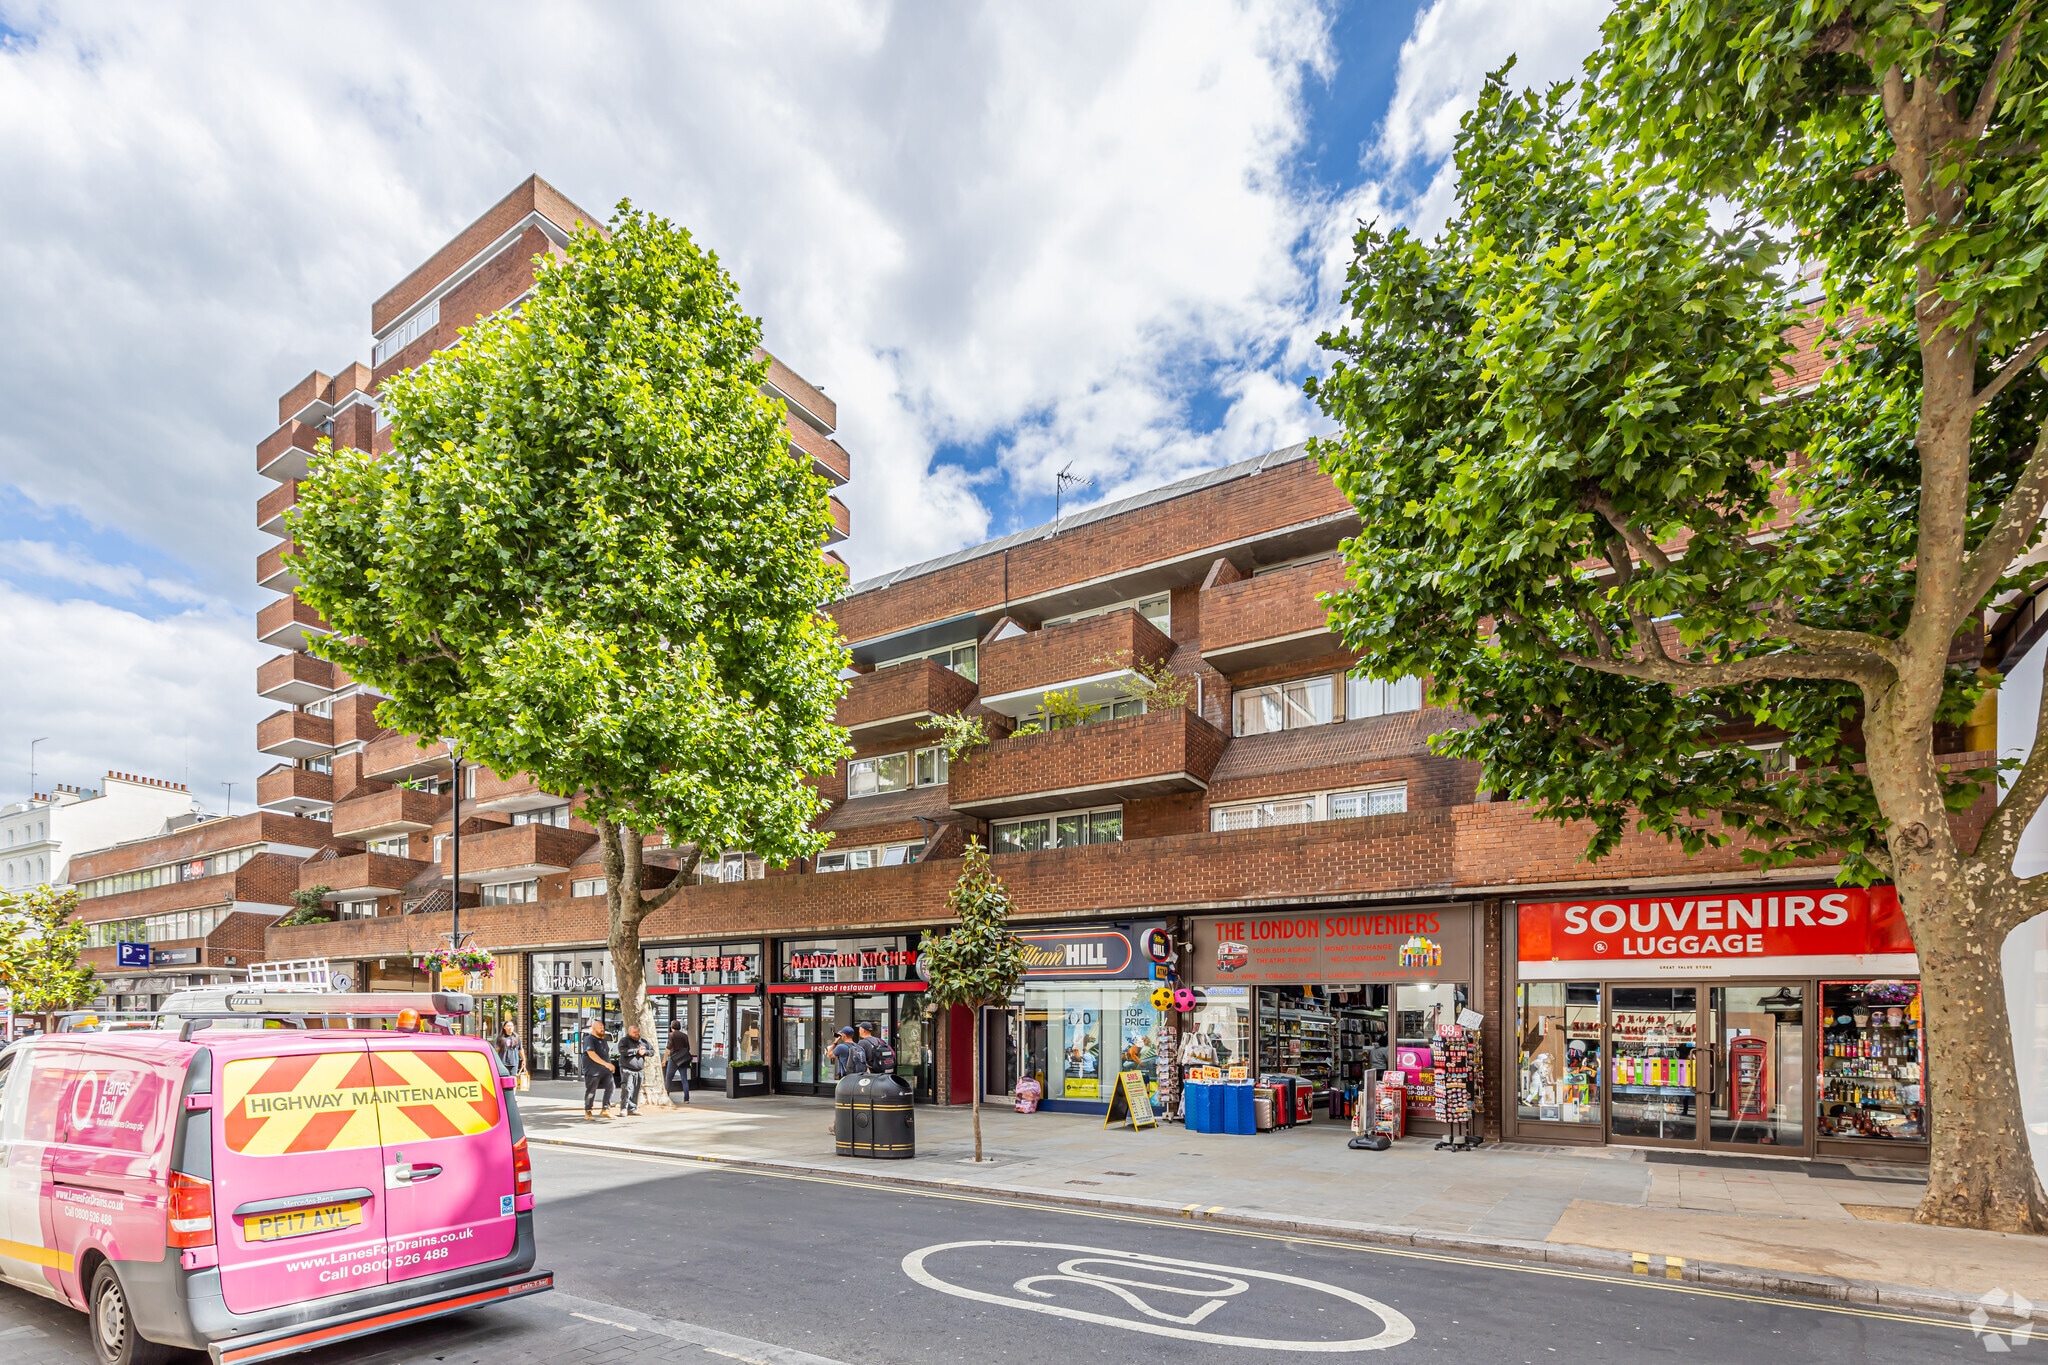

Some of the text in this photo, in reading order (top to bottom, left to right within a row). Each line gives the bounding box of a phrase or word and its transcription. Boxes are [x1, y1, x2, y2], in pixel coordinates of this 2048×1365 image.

[1563, 893, 1849, 936] SOUVENIRS
[1215, 912, 1441, 941] THE LONDON SOUVENIERS
[122, 946, 133, 959] P
[1065, 943, 1107, 966] HILL
[1153, 943, 1166, 957] HILL
[1252, 945, 1317, 954] TOUR BUS AGENCY
[1324, 943, 1393, 953] MONEY EXCHANGE
[1596, 934, 1764, 956] & LUGGAGE
[790, 950, 917, 969] MANDARIN KITCHEN
[1256, 957, 1286, 965] THEATRE
[1331, 955, 1342, 963] NO
[1265, 972, 1299, 980] TOBACCO
[839, 983, 877, 992] restaurant
[1124, 1017, 1151, 1027] PRICE
[1125, 1008, 1143, 1017] TOP
[103, 1077, 131, 1097] Lanes
[98, 1096, 117, 1116] Rail
[250, 1084, 479, 1113] HIGHWAY MAINTENANCE
[55, 1189, 124, 1212] www.LanesForDrains.co.uk
[283, 1196, 334, 1208] Mercedes-Benz
[64, 1206, 113, 1226] Call 0800 526 488
[259, 1207, 351, 1236] PF17 AYL
[286, 1227, 474, 1273] www.LanesForDrains.co.uk
[319, 1247, 449, 1283] Call 0800 526 488
